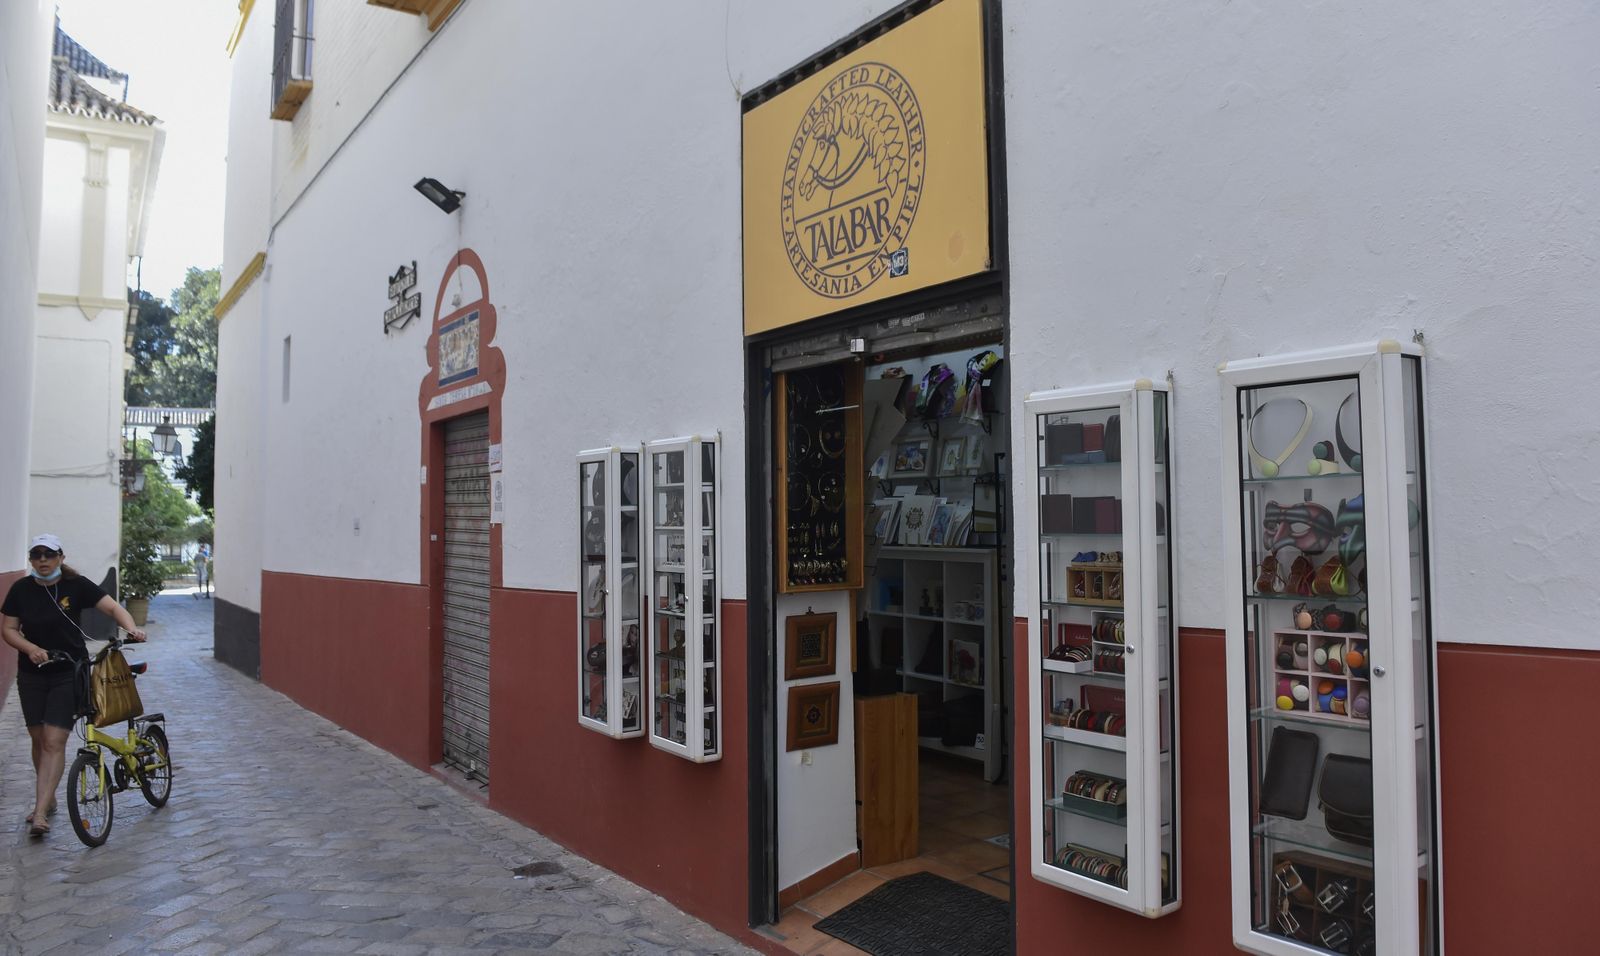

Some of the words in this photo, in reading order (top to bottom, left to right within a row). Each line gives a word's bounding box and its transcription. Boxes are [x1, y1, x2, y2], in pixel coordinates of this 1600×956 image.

[783, 67, 870, 211] HANDCRAFTED
[875, 68, 923, 158] LEATHER
[785, 230, 863, 295] ARTESANIA
[892, 174, 922, 243] PIEL
[803, 196, 894, 264] TALABAR
